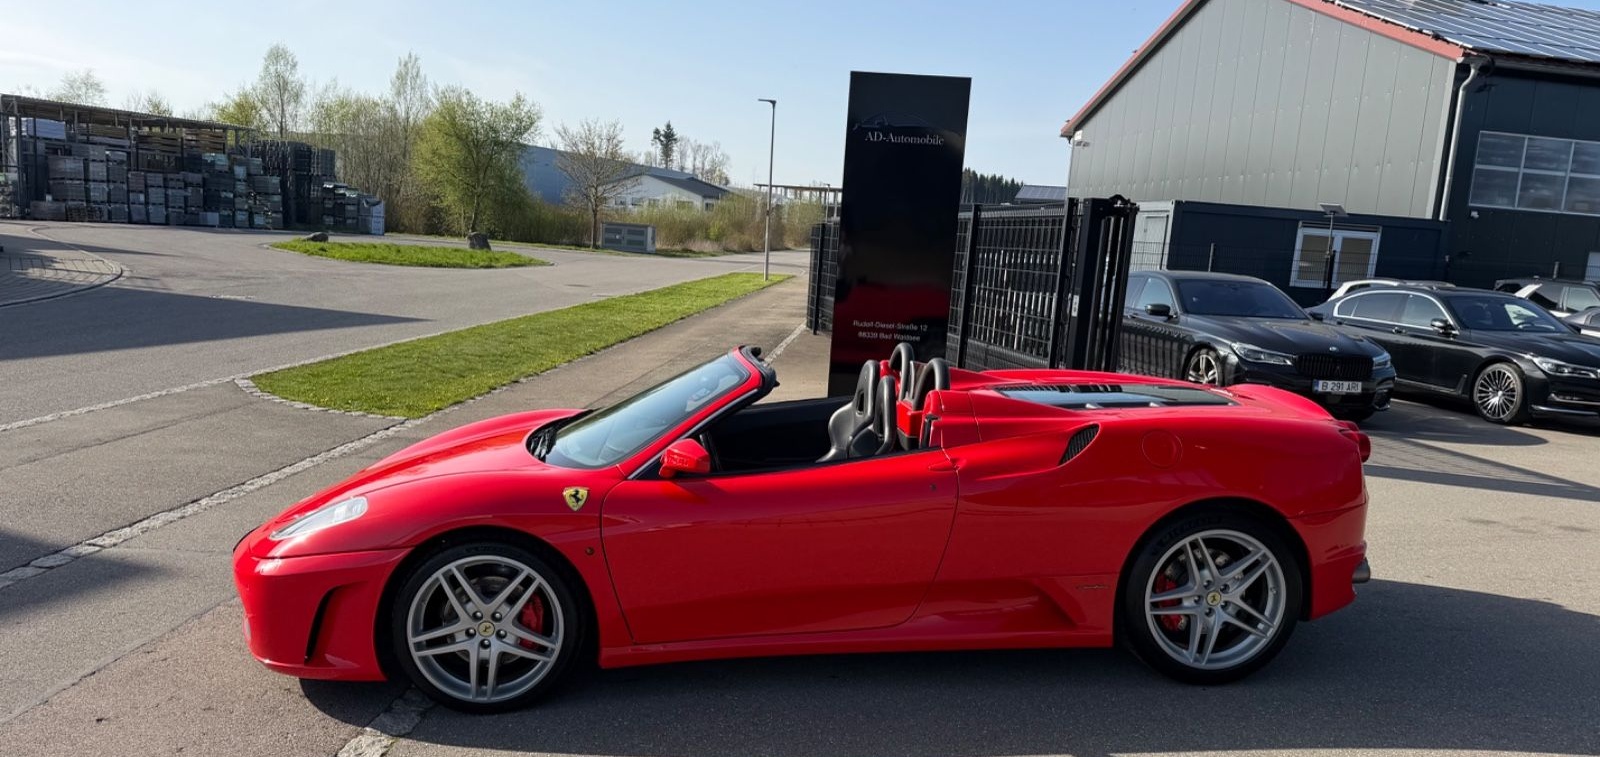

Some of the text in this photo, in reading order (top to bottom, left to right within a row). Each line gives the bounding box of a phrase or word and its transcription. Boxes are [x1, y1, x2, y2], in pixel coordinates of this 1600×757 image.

[864, 131, 944, 146] AD-Automobile
[879, 332, 892, 340] Bad
[1321, 381, 1359, 392] B 291 ARI
